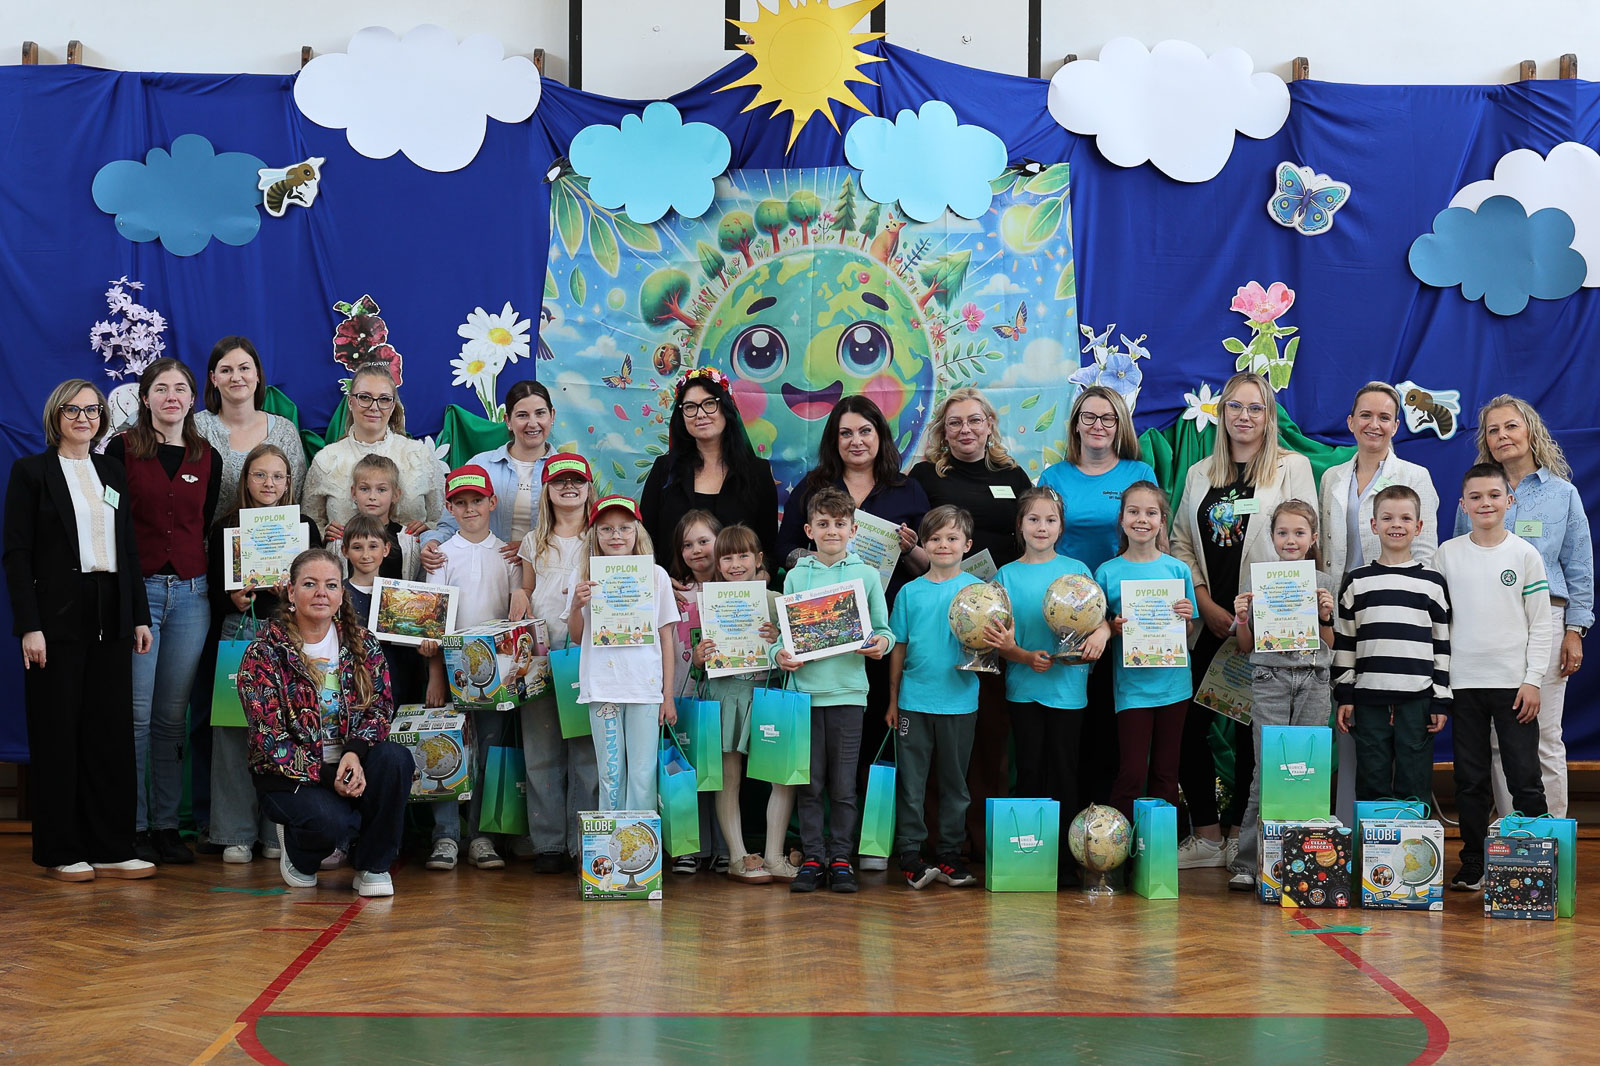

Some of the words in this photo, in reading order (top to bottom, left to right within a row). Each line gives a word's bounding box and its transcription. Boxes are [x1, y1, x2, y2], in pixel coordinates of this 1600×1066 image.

[254, 514, 285, 523] DYPLOM
[856, 520, 900, 542] ODZIĘKOWANIA
[605, 565, 638, 573] DYPLOM
[1266, 570, 1300, 578] DYPLOM
[442, 637, 462, 646] GLOBE
[390, 733, 416, 743] GLOBE
[584, 820, 612, 831] GLOBE
[1266, 825, 1283, 836] GLO
[1365, 829, 1397, 840] GLOBE
